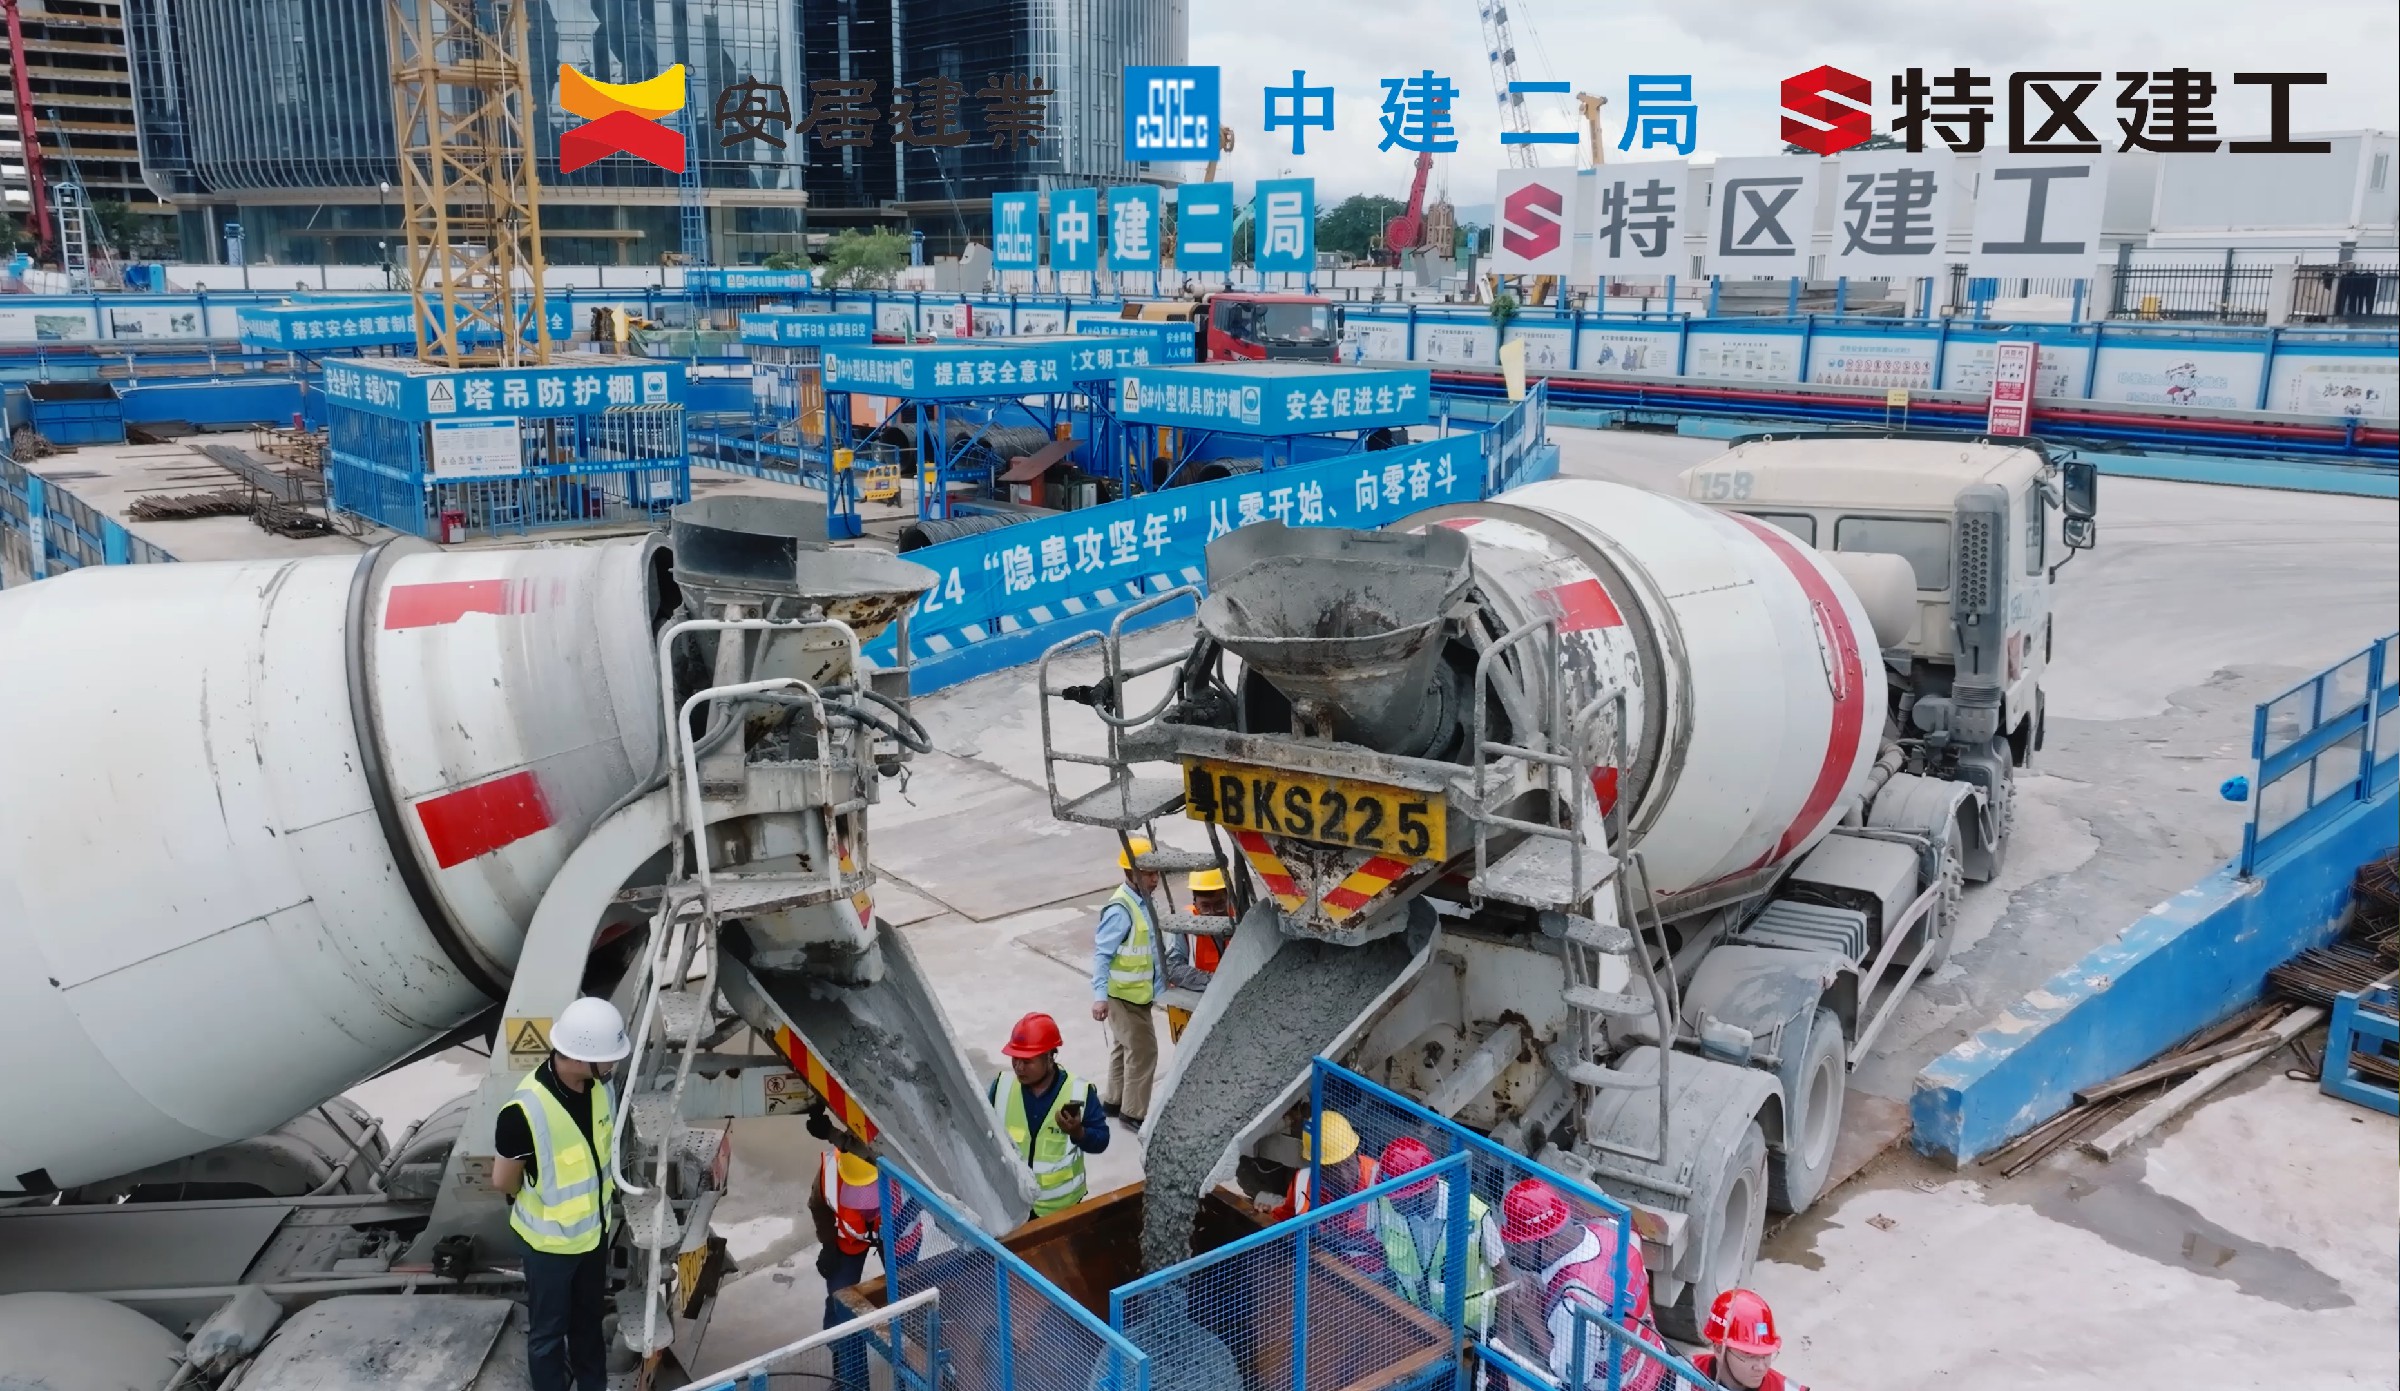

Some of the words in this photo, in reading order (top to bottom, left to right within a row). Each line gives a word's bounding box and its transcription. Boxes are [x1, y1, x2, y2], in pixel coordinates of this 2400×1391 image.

[1057, 192, 1305, 262] 中建二局
[1600, 165, 2091, 259] 特区建工
[291, 314, 417, 340] 落实安全规章制度
[934, 359, 1058, 386] 提高安全意识
[1071, 346, 1150, 371] 文明工地
[326, 367, 362, 400] 安全是个宝
[463, 375, 636, 411] 塔吊防护棚
[1141, 384, 1241, 419] 6#小型机具防护棚
[1286, 384, 1417, 421] 安全促进生产
[1699, 470, 1755, 501] 158
